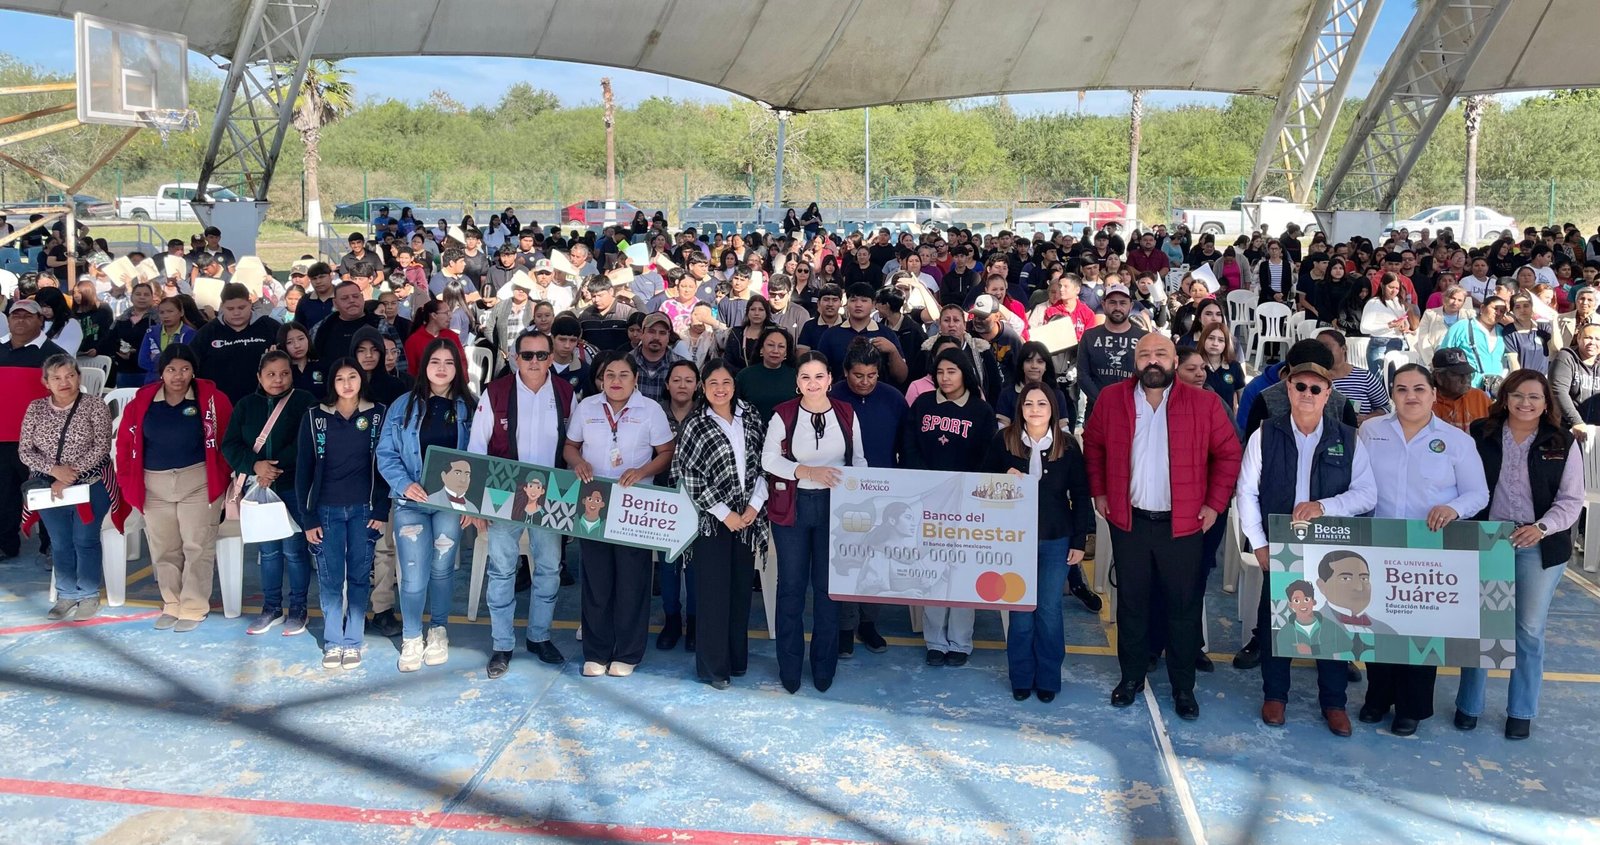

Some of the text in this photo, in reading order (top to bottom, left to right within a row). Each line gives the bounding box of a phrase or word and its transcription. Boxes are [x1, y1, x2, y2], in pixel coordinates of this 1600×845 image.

[211, 337, 266, 349] Champion
[1093, 335, 1139, 350] AE-US
[1097, 368, 1133, 378] TRADITION
[921, 414, 973, 439] SPORT
[860, 482, 890, 492] México
[621, 493, 678, 515] Benito
[618, 510, 677, 531] Juárez
[923, 510, 985, 523] Banco del
[922, 522, 1026, 543] Bienestar
[1314, 523, 1351, 535] Becas
[839, 543, 1013, 566] 0000 0000 0000 0000
[908, 568, 938, 579] 00/00
[1385, 567, 1459, 586] Benito
[1385, 585, 1460, 605] Juárez
[1385, 602, 1419, 610] Educación
